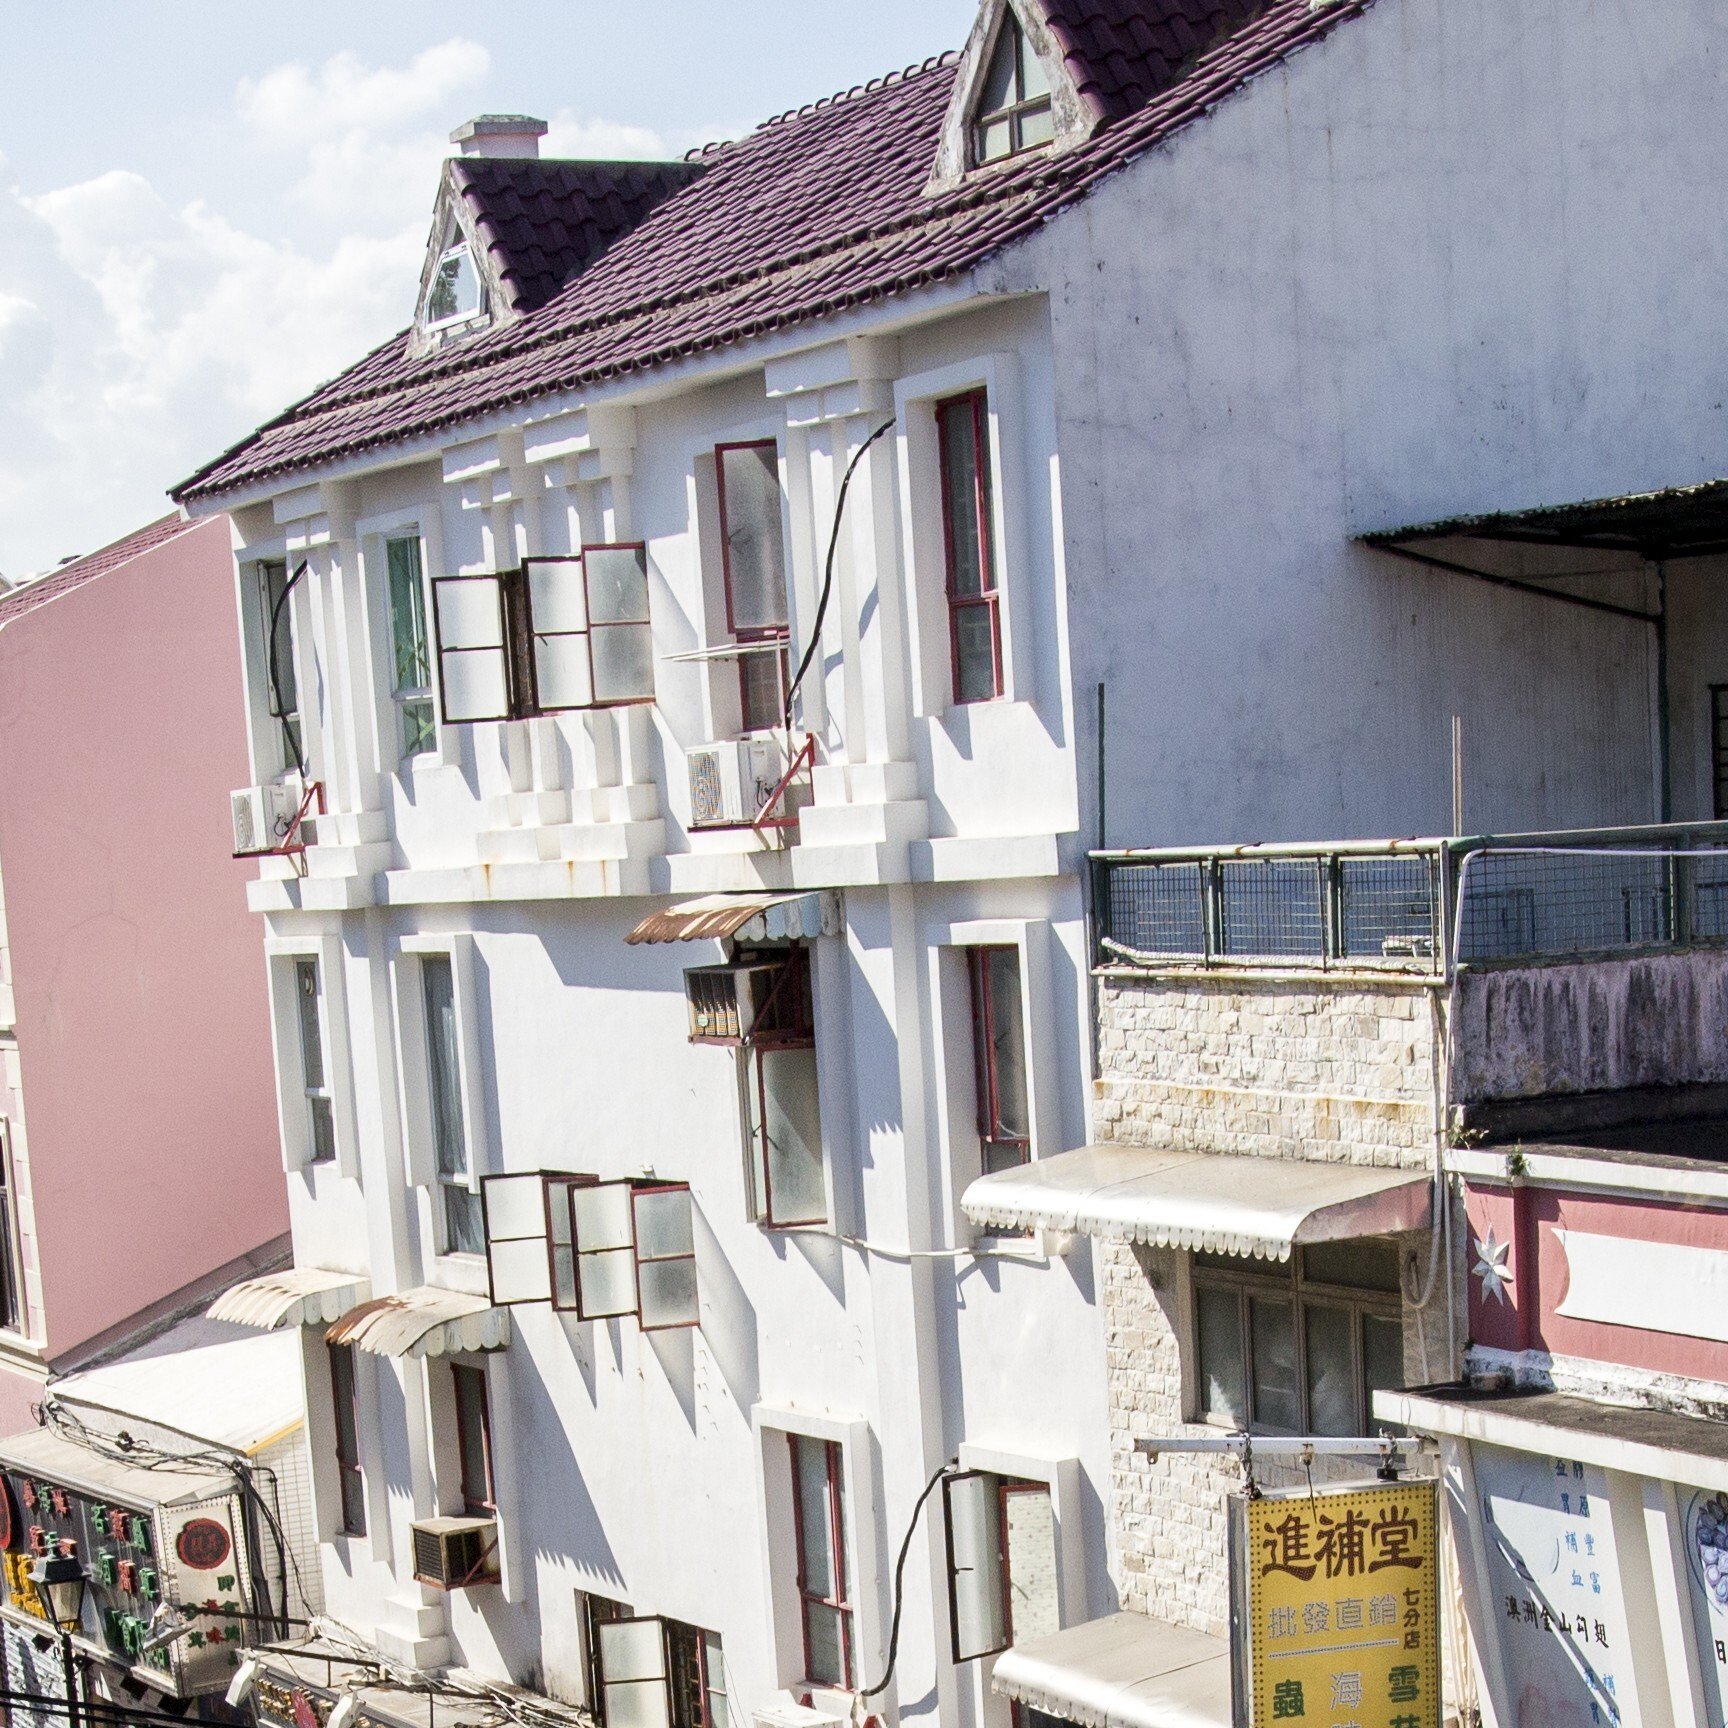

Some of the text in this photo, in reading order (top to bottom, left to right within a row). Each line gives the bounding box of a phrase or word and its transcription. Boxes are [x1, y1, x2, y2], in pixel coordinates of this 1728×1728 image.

[1261, 1505, 1424, 1582] 進補堂
[1268, 1593, 1399, 1640] 批發直銷
[1403, 1587, 1421, 1651] 七分店
